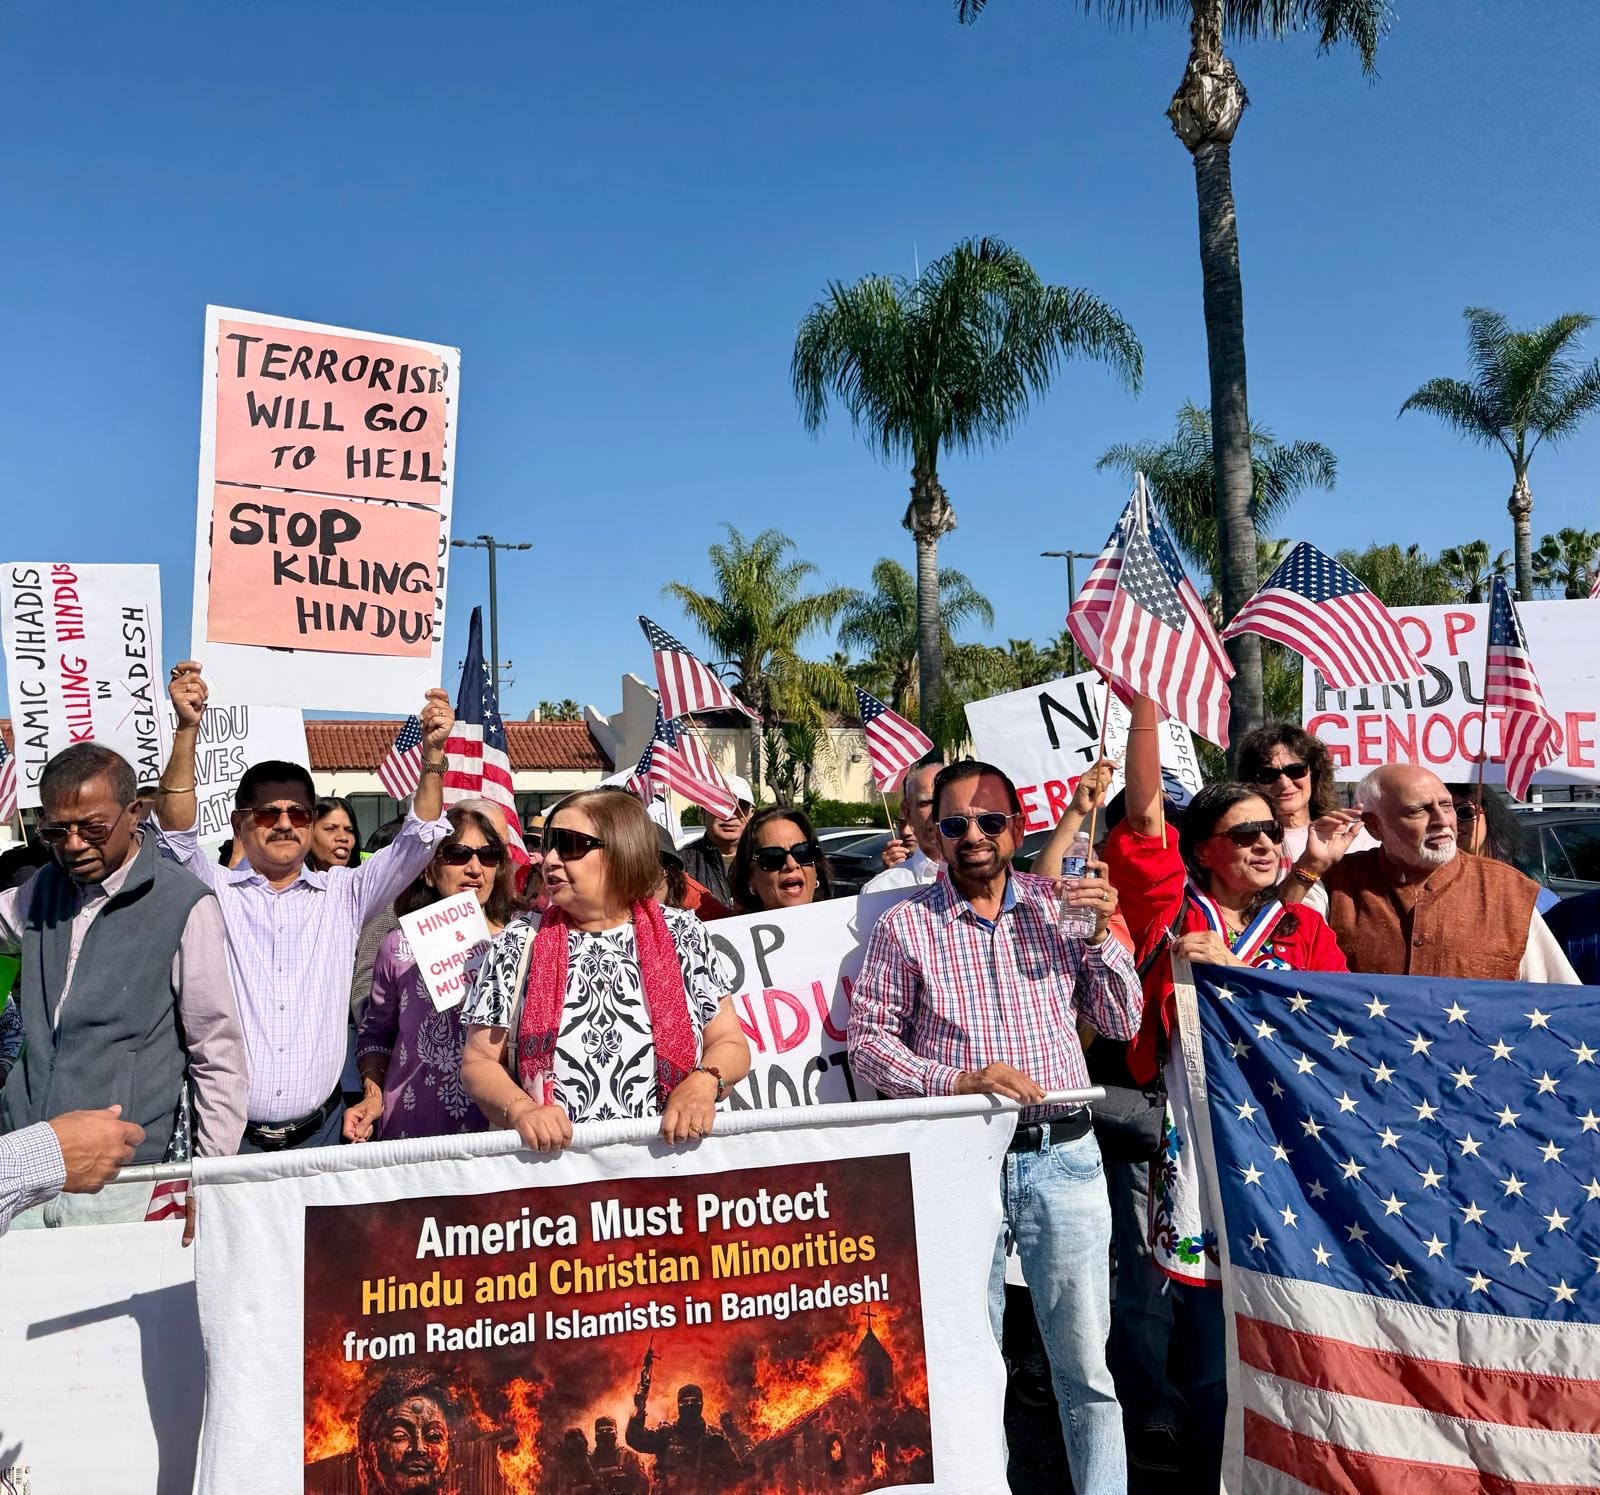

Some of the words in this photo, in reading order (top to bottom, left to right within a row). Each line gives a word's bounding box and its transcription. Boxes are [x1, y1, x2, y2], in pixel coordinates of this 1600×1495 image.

[246, 391, 344, 432] WILL
[364, 403, 428, 433] GO
[271, 445, 316, 471] TO
[346, 445, 442, 483] HELL
[229, 502, 362, 556] STOP
[273, 550, 434, 595] KILLING
[12, 567, 46, 670] JIHADIS
[50, 564, 86, 643] HINDUS
[296, 596, 434, 644] HINDUS
[1400, 612, 1476, 658] OP
[60, 654, 96, 744] KILLING
[96, 680, 112, 699] IN
[121, 606, 161, 785] BANGLADESH
[19, 680, 49, 788] ISLAMIC
[168, 704, 249, 744] NDU
[194, 745, 249, 786] VES
[1167, 715, 1198, 791] ESPECT
[416, 901, 476, 936] HINDUS
[455, 930, 467, 942] &
[711, 923, 786, 996] OP
[415, 1206, 578, 1260] America
[590, 1197, 684, 1242] Must
[697, 1182, 830, 1233] Protect
[362, 1271, 463, 1316] Hindu
[475, 1261, 537, 1304] and
[550, 1248, 700, 1296] Christian
[711, 1230, 877, 1279] Minorities
[343, 1331, 416, 1362] from
[426, 1313, 535, 1353] Radical
[546, 1300, 677, 1341] Islamists
[685, 1296, 712, 1325] in
[721, 1273, 890, 1322] Bangladesh!
